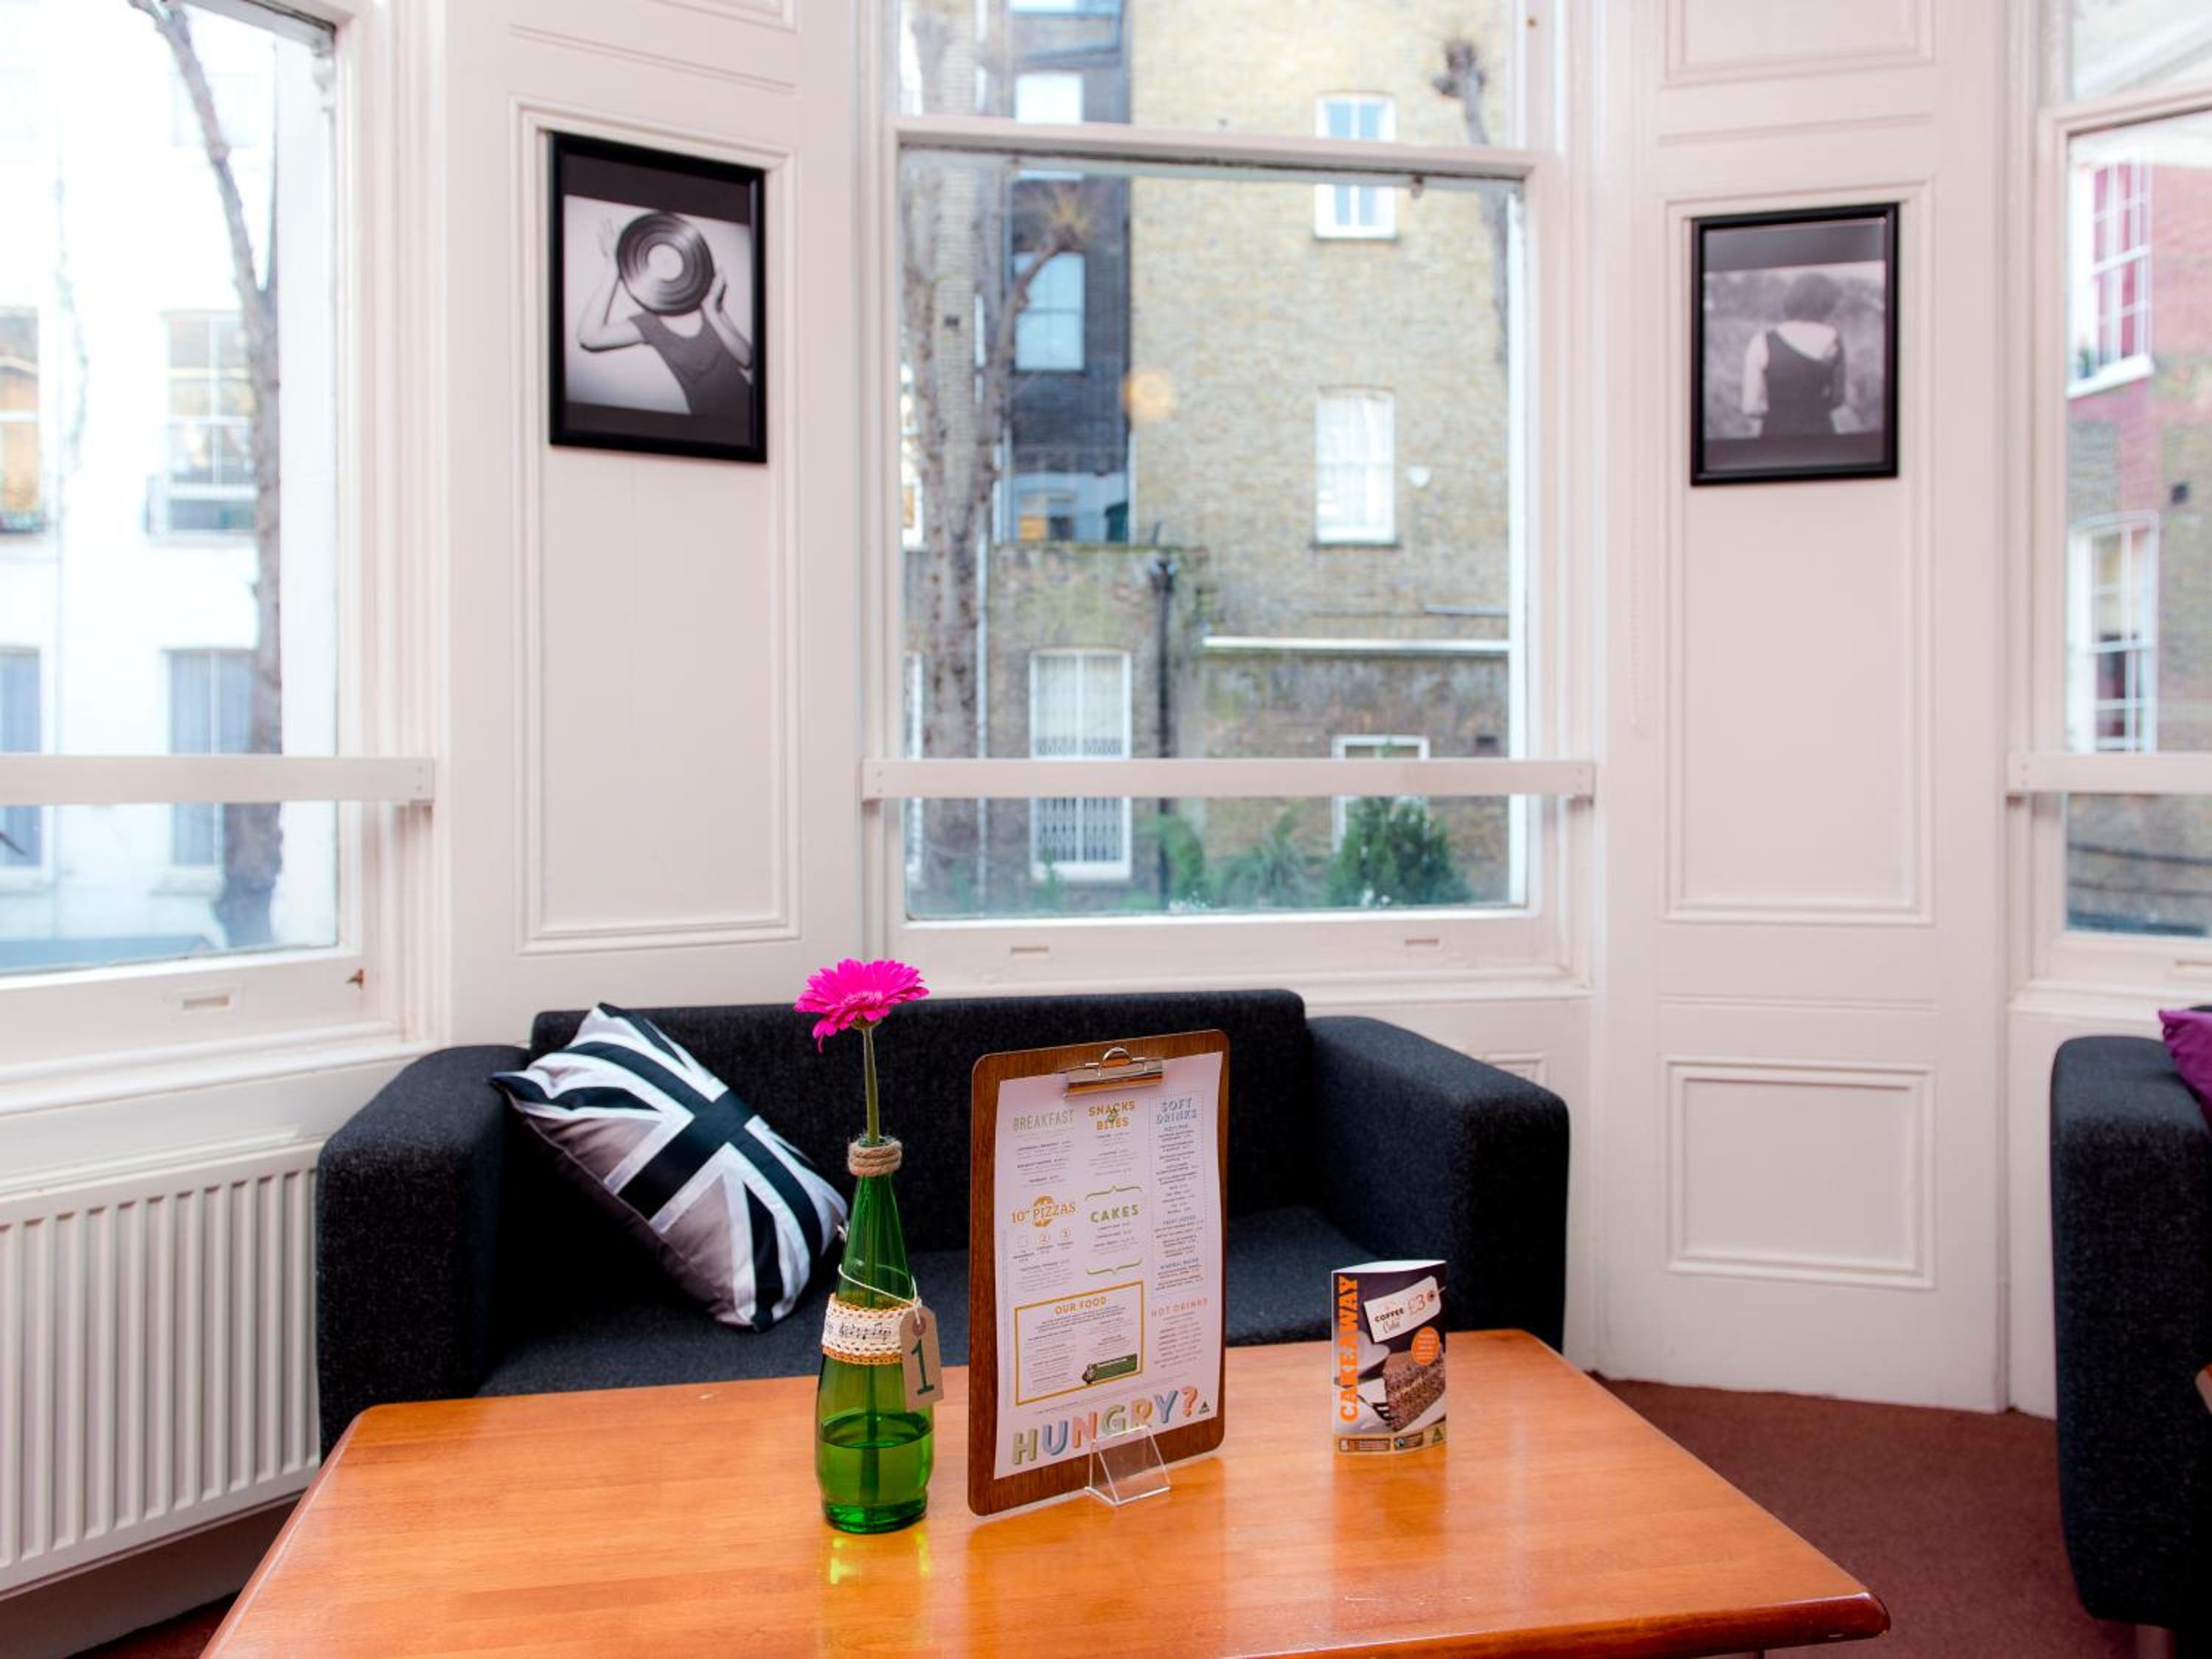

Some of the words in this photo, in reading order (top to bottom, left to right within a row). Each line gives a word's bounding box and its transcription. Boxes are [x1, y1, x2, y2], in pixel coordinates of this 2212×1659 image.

[1088, 1101, 1135, 1116] SNACKS
[1013, 1109, 1074, 1132] BREAKFAST
[1096, 1117, 1129, 1131] BITES
[1033, 1203, 1076, 1220] PIZZAS
[1090, 1204, 1140, 1223] CAKES
[1055, 1302, 1077, 1315] OUR
[1080, 1297, 1107, 1310] FOOD
[1152, 1303, 1171, 1317] HOT
[1173, 1298, 1208, 1312] DRINKS
[1374, 1307, 1405, 1322] COFFEE
[911, 1338, 934, 1395] 1
[1012, 1386, 1198, 1466] HUNGRY?
